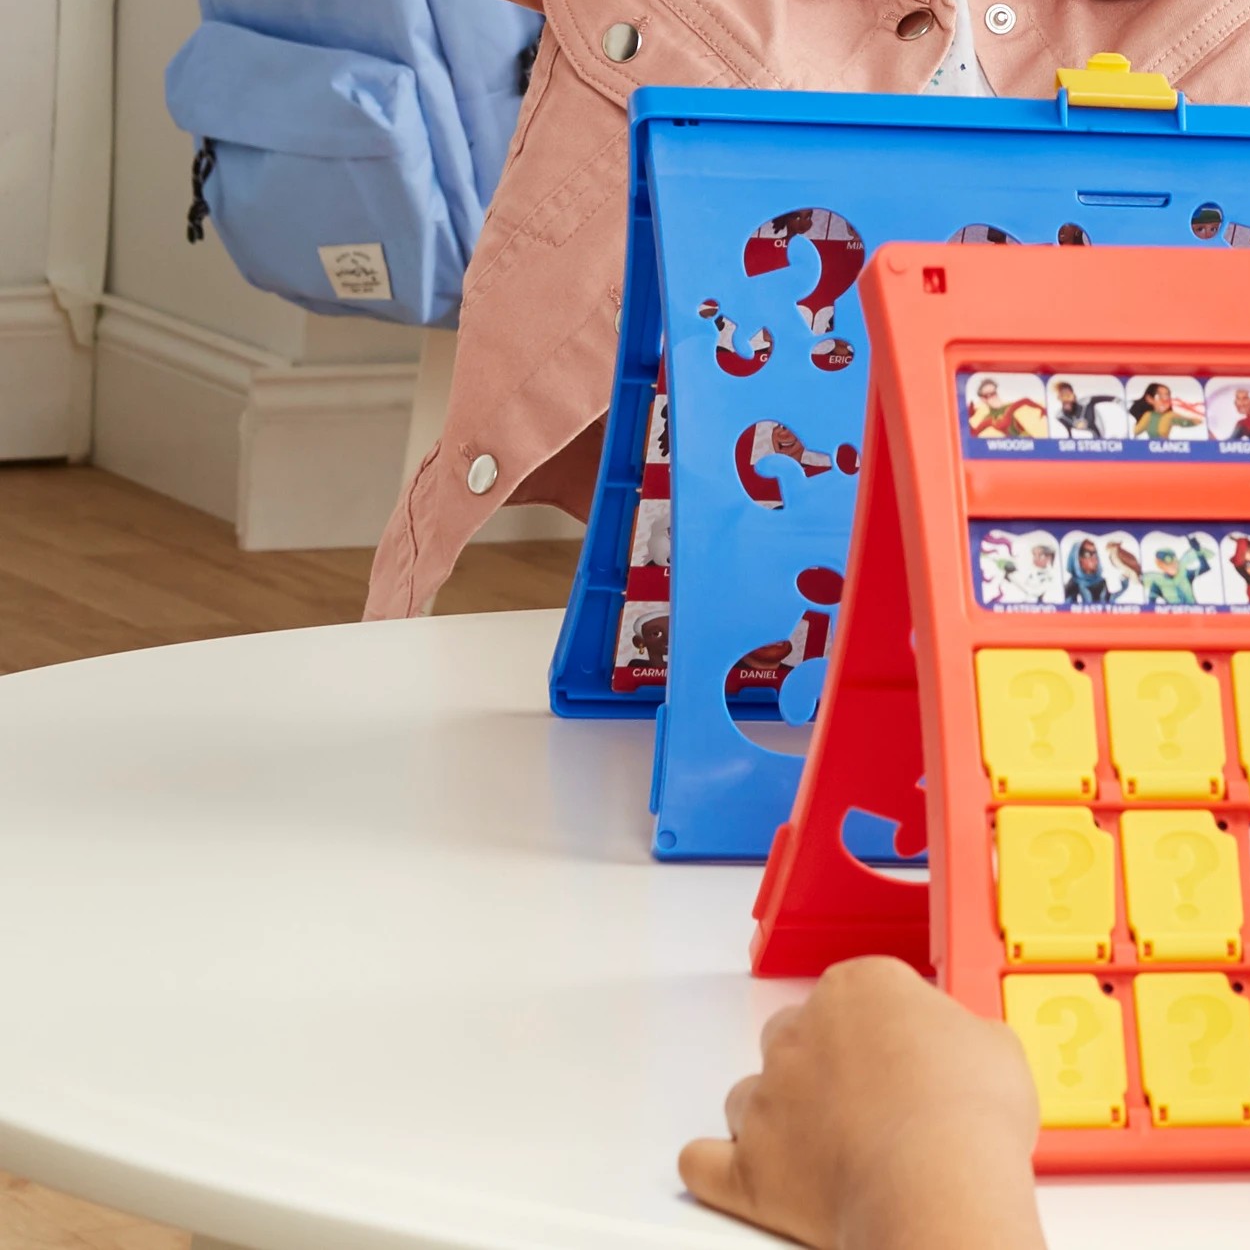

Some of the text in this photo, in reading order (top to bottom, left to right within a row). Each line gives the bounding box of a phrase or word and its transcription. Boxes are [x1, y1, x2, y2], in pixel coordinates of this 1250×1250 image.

[987, 439, 1034, 451] WHOOSH
[1059, 440, 1123, 452] SIR STRETCH
[1149, 440, 1190, 452] GLANCE
[740, 669, 778, 679] DANIEL
